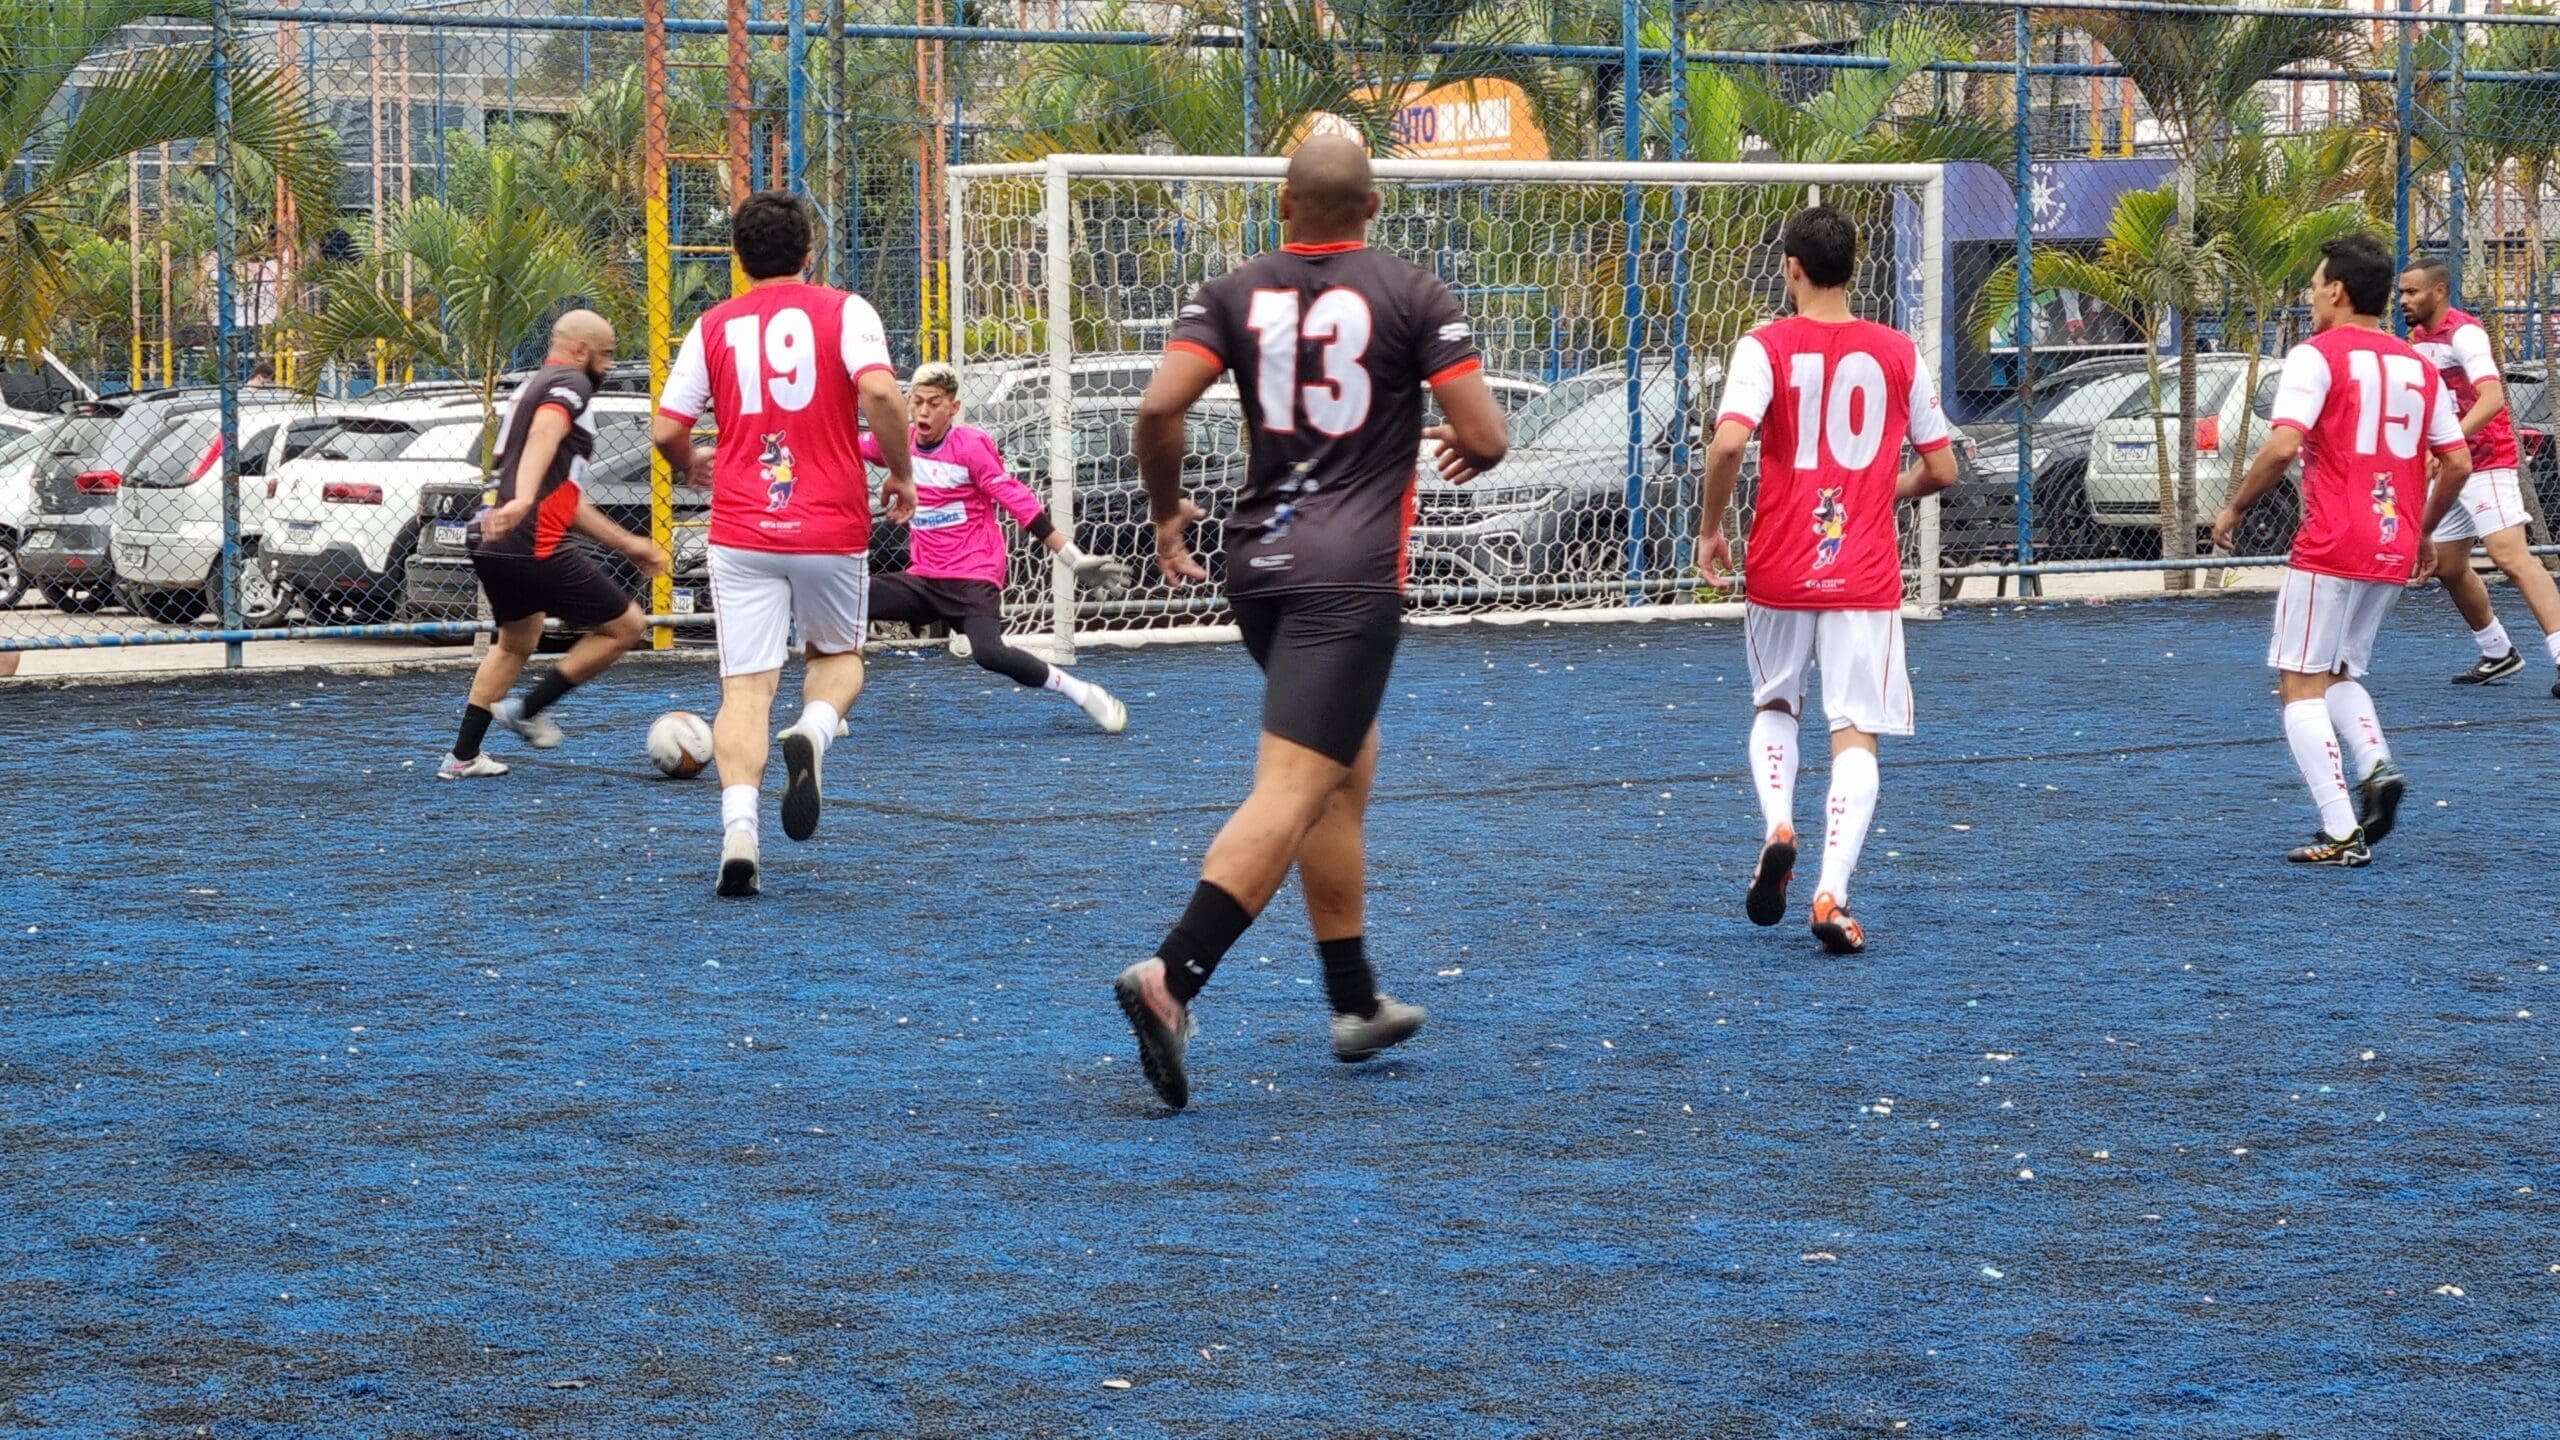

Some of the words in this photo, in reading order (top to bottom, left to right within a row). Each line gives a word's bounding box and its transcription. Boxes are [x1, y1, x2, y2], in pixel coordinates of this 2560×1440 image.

[724, 307, 818, 415] 19
[1246, 285, 1373, 437] 13
[1790, 351, 1888, 472] 10
[2348, 350, 2427, 460] 15
